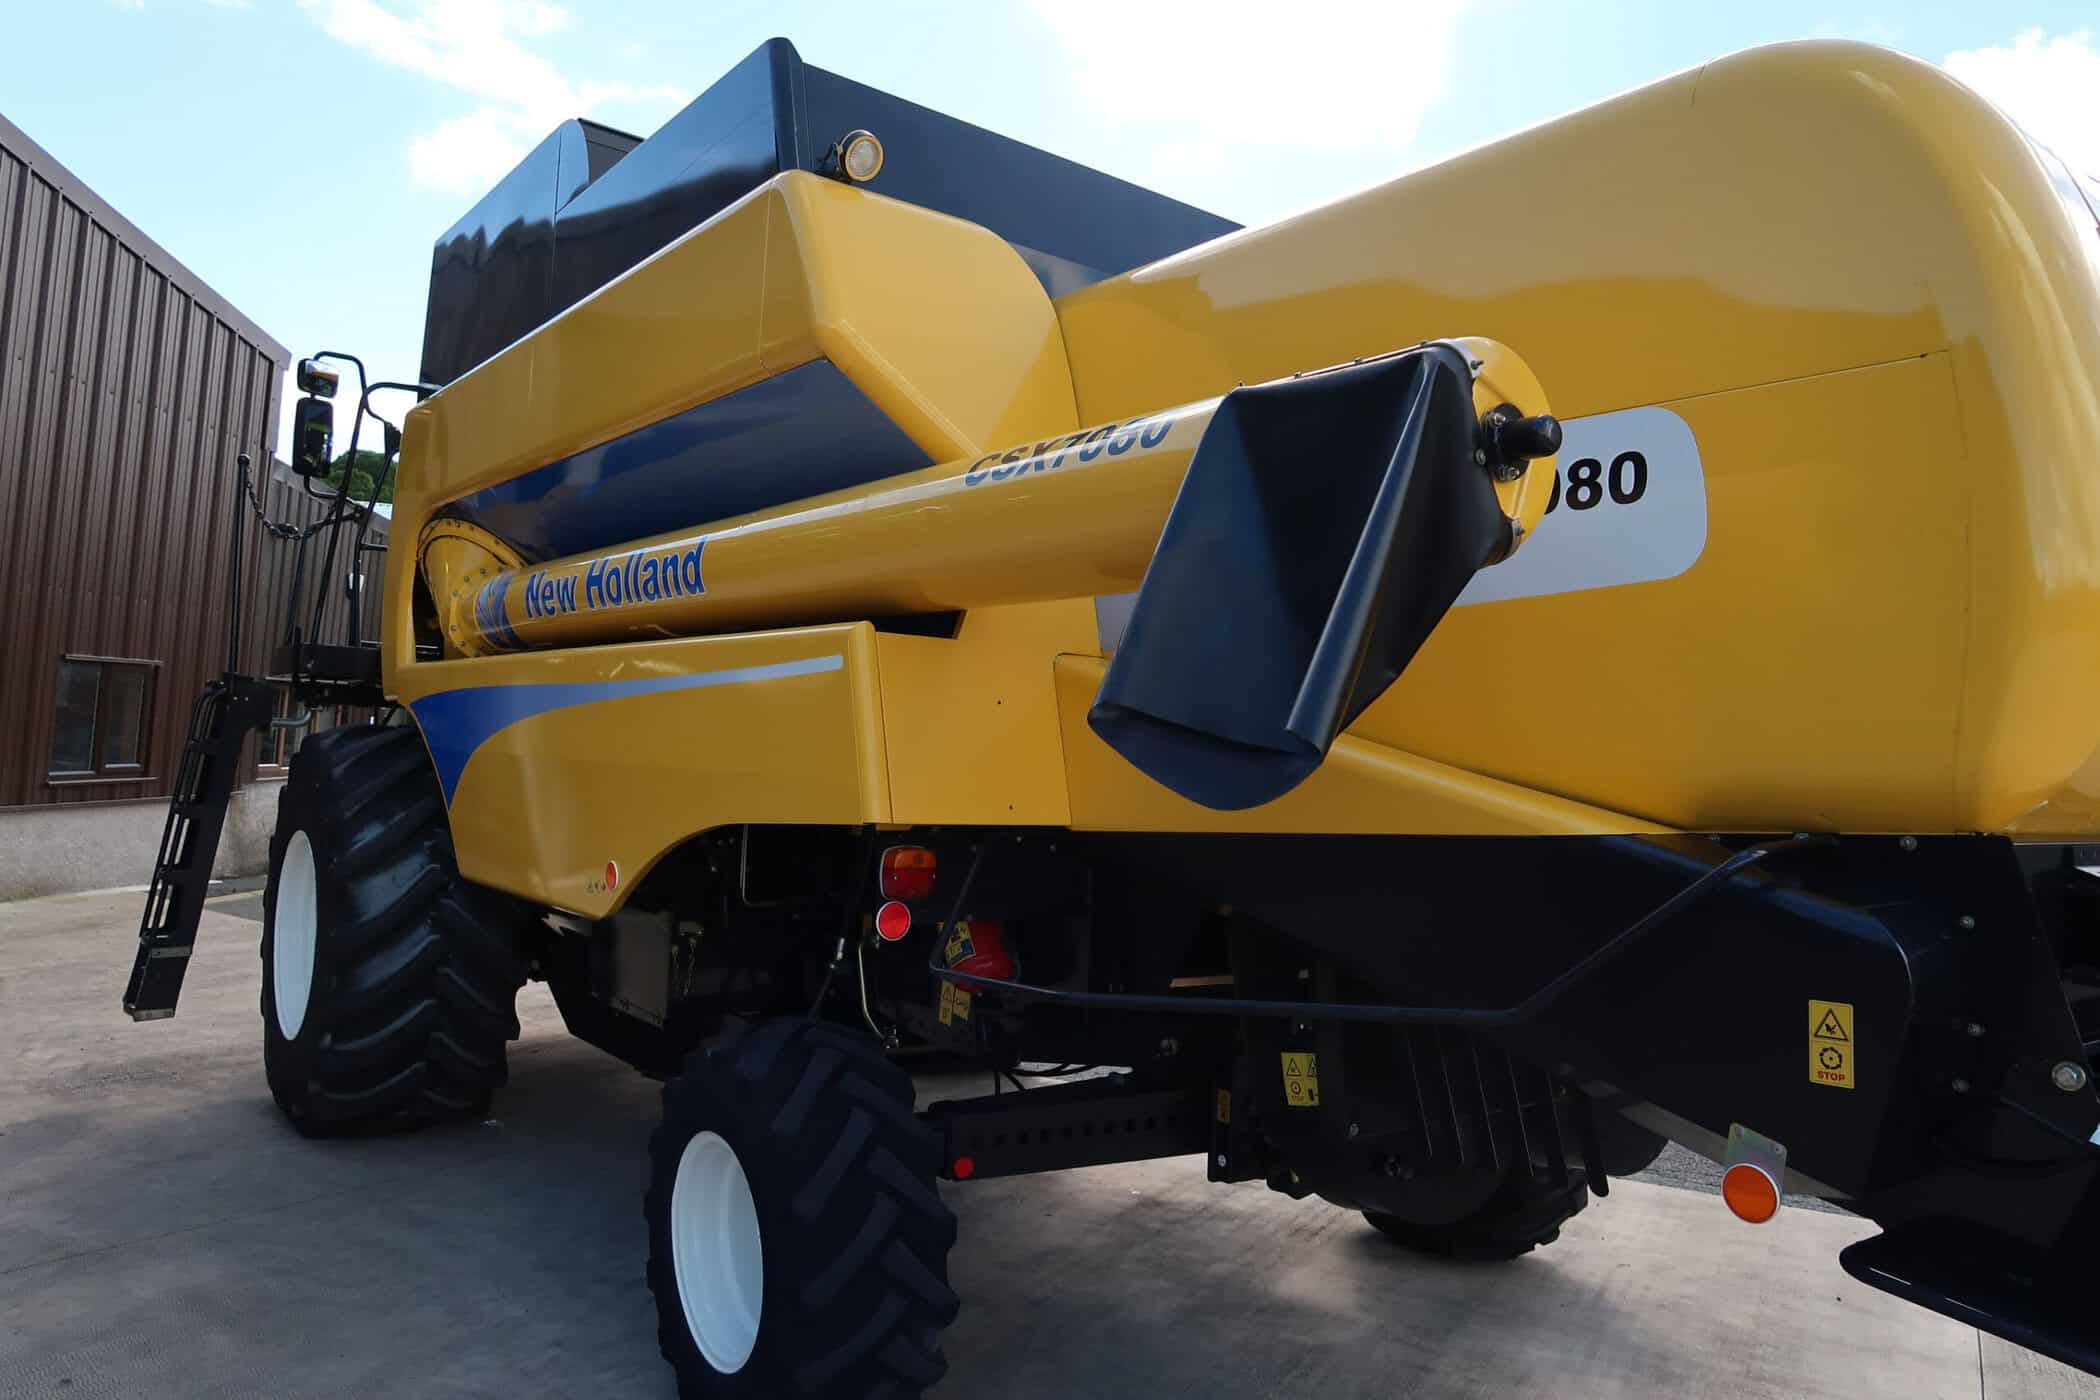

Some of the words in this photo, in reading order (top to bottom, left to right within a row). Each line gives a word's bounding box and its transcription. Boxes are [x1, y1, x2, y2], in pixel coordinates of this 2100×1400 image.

[524, 572, 577, 618] New
[585, 537, 709, 609] Holland
[1817, 1071, 1845, 1081] STOP
